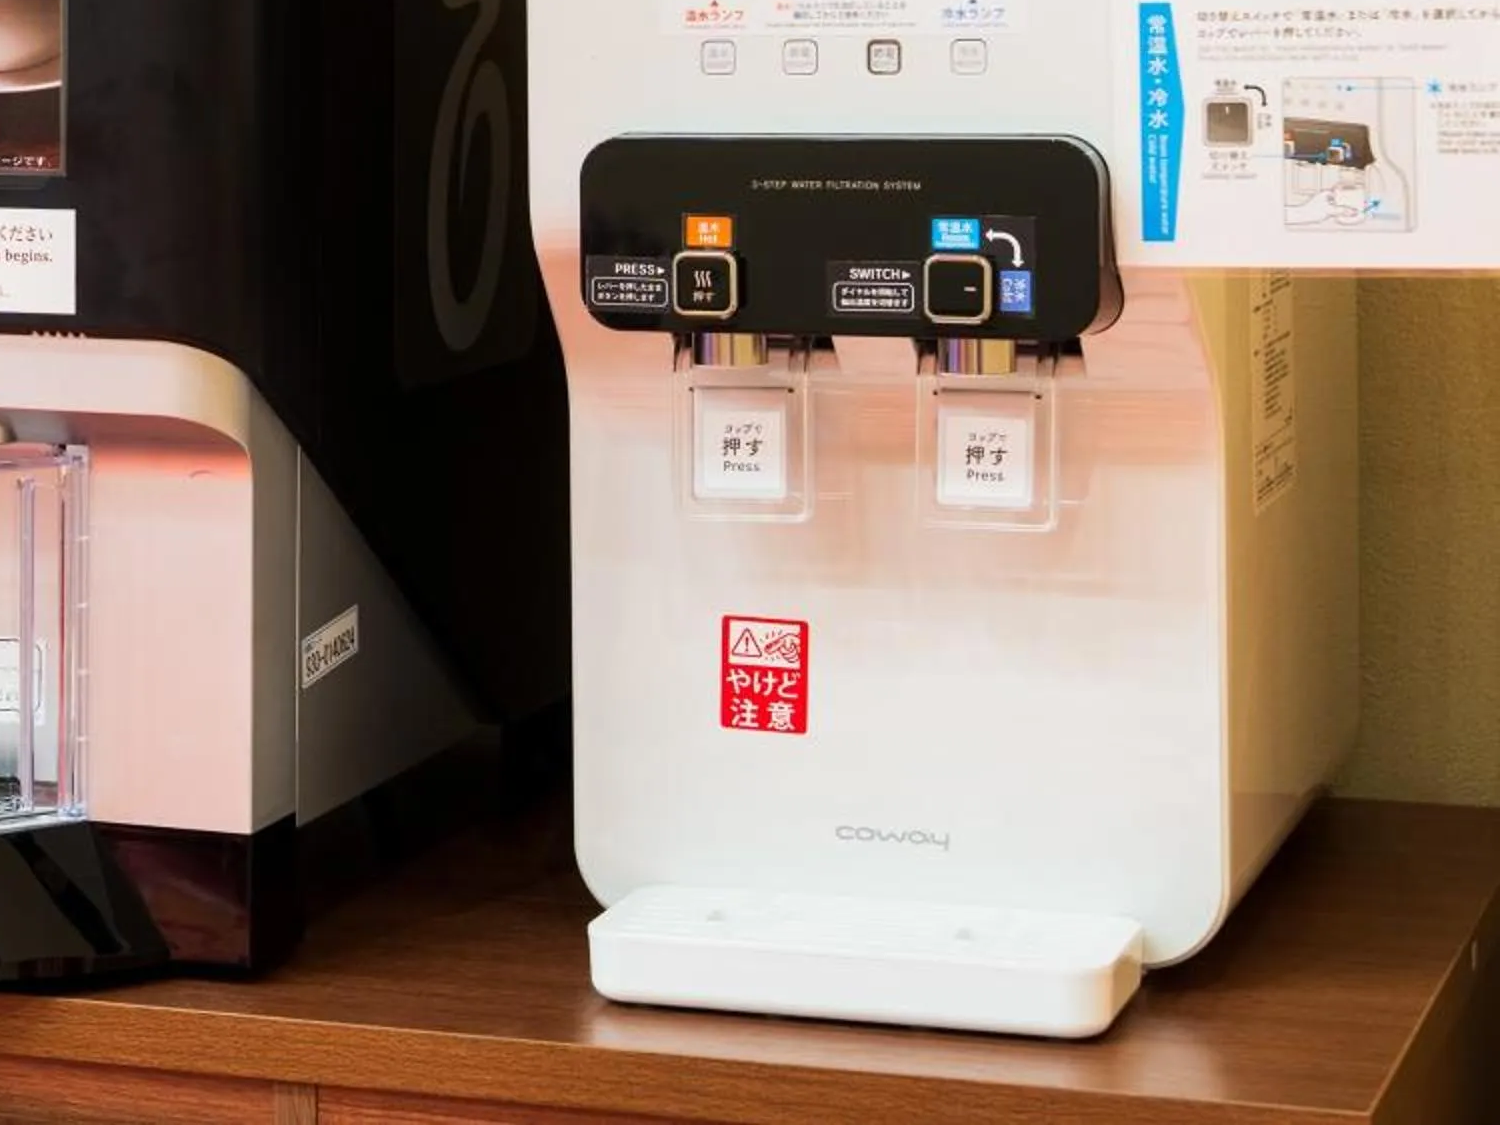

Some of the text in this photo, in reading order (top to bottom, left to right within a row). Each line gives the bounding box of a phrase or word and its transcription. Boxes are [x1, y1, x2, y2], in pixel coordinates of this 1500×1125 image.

[5, 249, 53, 265] begins.
[614, 262, 655, 276] PRESS
[849, 268, 900, 280] SWITCH
[723, 437, 763, 457] 押す
[965, 445, 1008, 465] 押す
[723, 460, 761, 472] Press
[966, 468, 1004, 482] Press
[726, 667, 801, 699] やけど
[729, 698, 796, 732] 注意
[834, 824, 950, 852] coway
